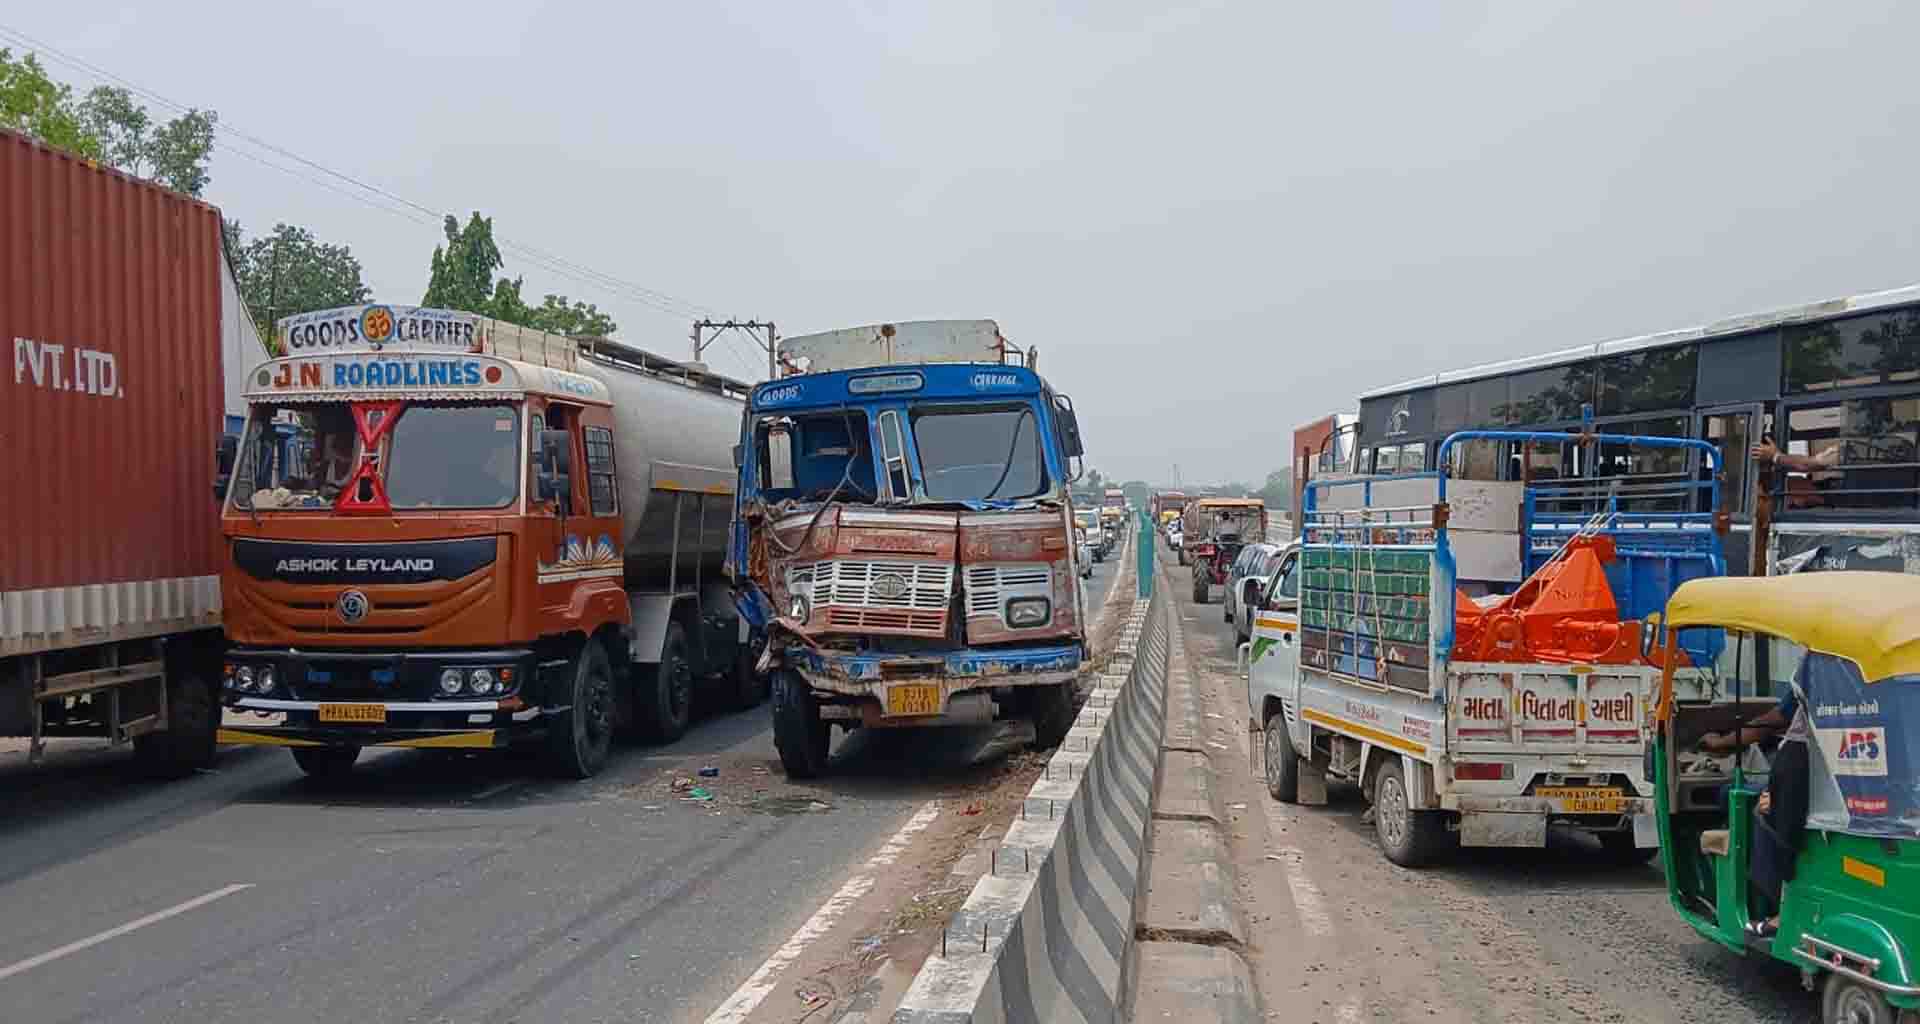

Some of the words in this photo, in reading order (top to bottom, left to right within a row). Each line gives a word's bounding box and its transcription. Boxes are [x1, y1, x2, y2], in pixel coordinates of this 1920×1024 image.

[290, 318, 359, 348] GOODS
[397, 318, 474, 345] CARRIER
[14, 337, 70, 391] PVT.
[73, 346, 124, 399] LTD.
[335, 359, 481, 386] ROADLINES
[276, 559, 339, 572] ASHOK
[345, 558, 434, 571] LEYLAND
